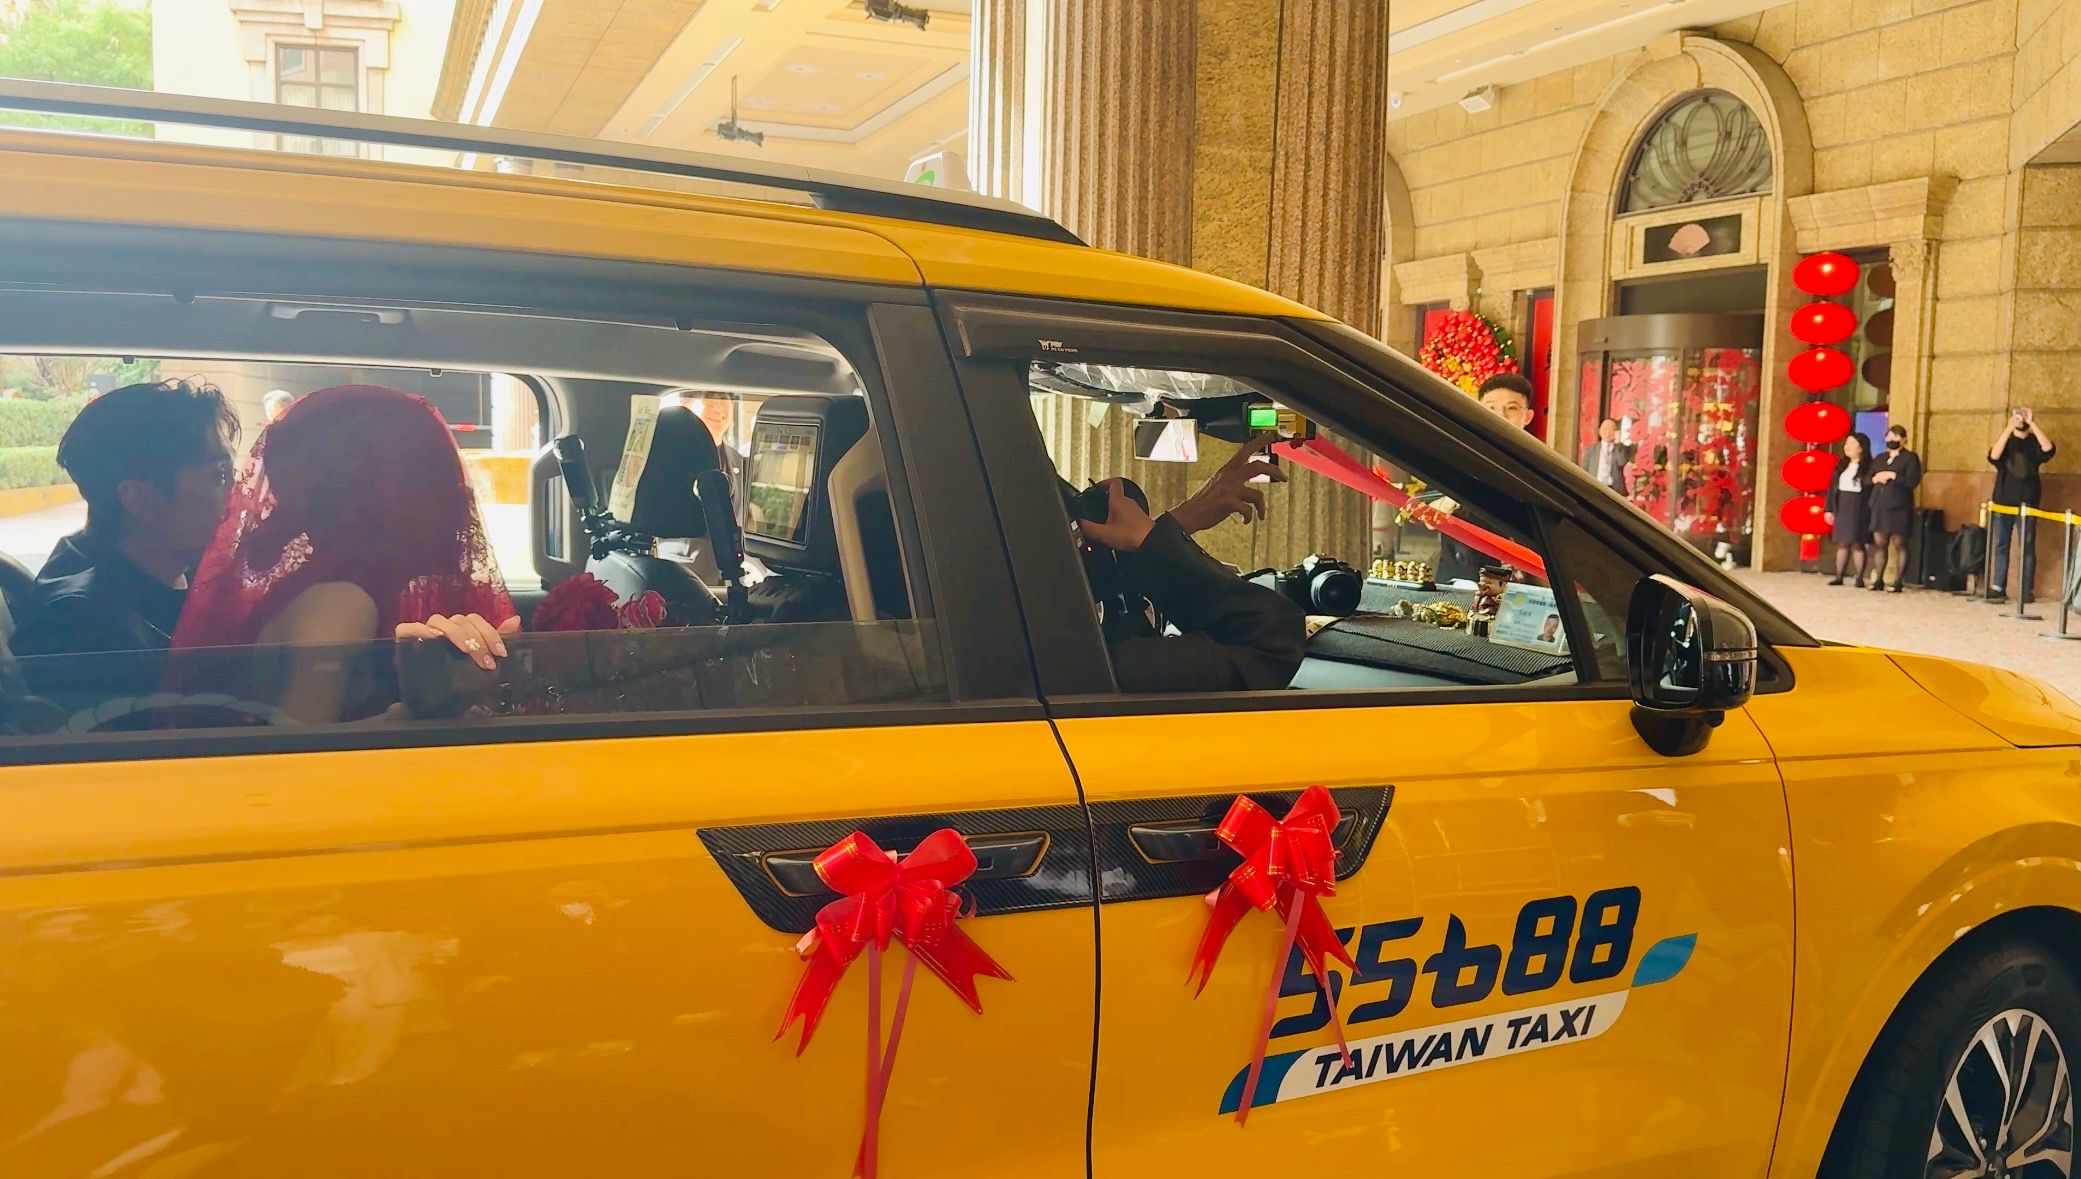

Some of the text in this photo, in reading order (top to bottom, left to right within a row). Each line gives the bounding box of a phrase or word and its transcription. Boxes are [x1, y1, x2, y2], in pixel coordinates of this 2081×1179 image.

[1269, 885, 1642, 1038] 55688
[1314, 1005, 1597, 1088] TAIWAN TAXI
